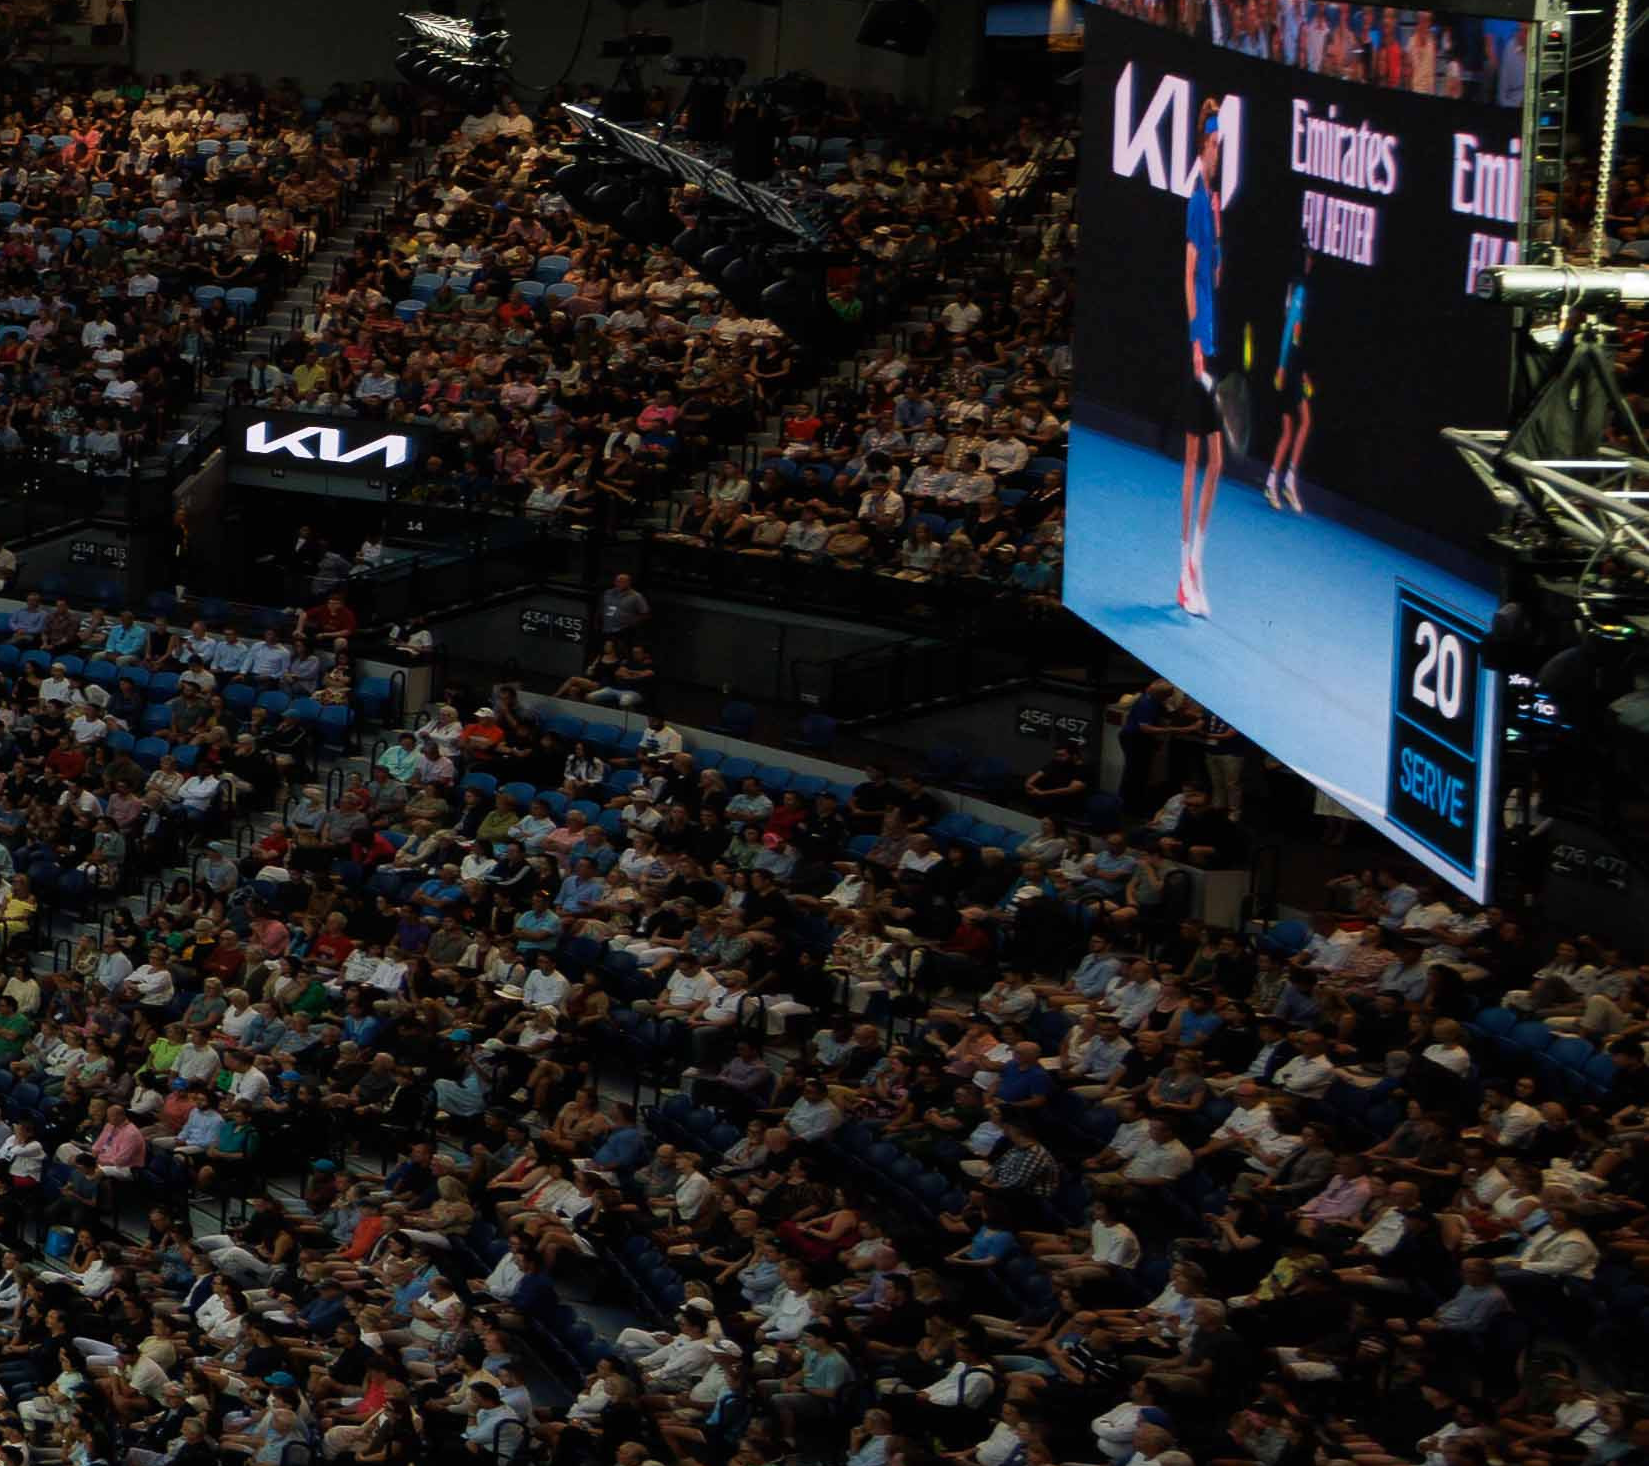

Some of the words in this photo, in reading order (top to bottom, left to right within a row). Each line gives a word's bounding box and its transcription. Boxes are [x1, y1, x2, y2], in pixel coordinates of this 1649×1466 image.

[1112, 60, 1241, 212] KIA
[1291, 97, 1399, 196] Emirates
[246, 420, 408, 468] KIA
[406, 520, 424, 532] 14
[521, 611, 550, 624] 434
[555, 615, 583, 630] 435
[1411, 620, 1462, 720] 20
[1019, 709, 1053, 725] 456
[1055, 716, 1090, 732] 457
[1399, 745, 1467, 829] SERVE
[1551, 844, 1588, 865] 476
